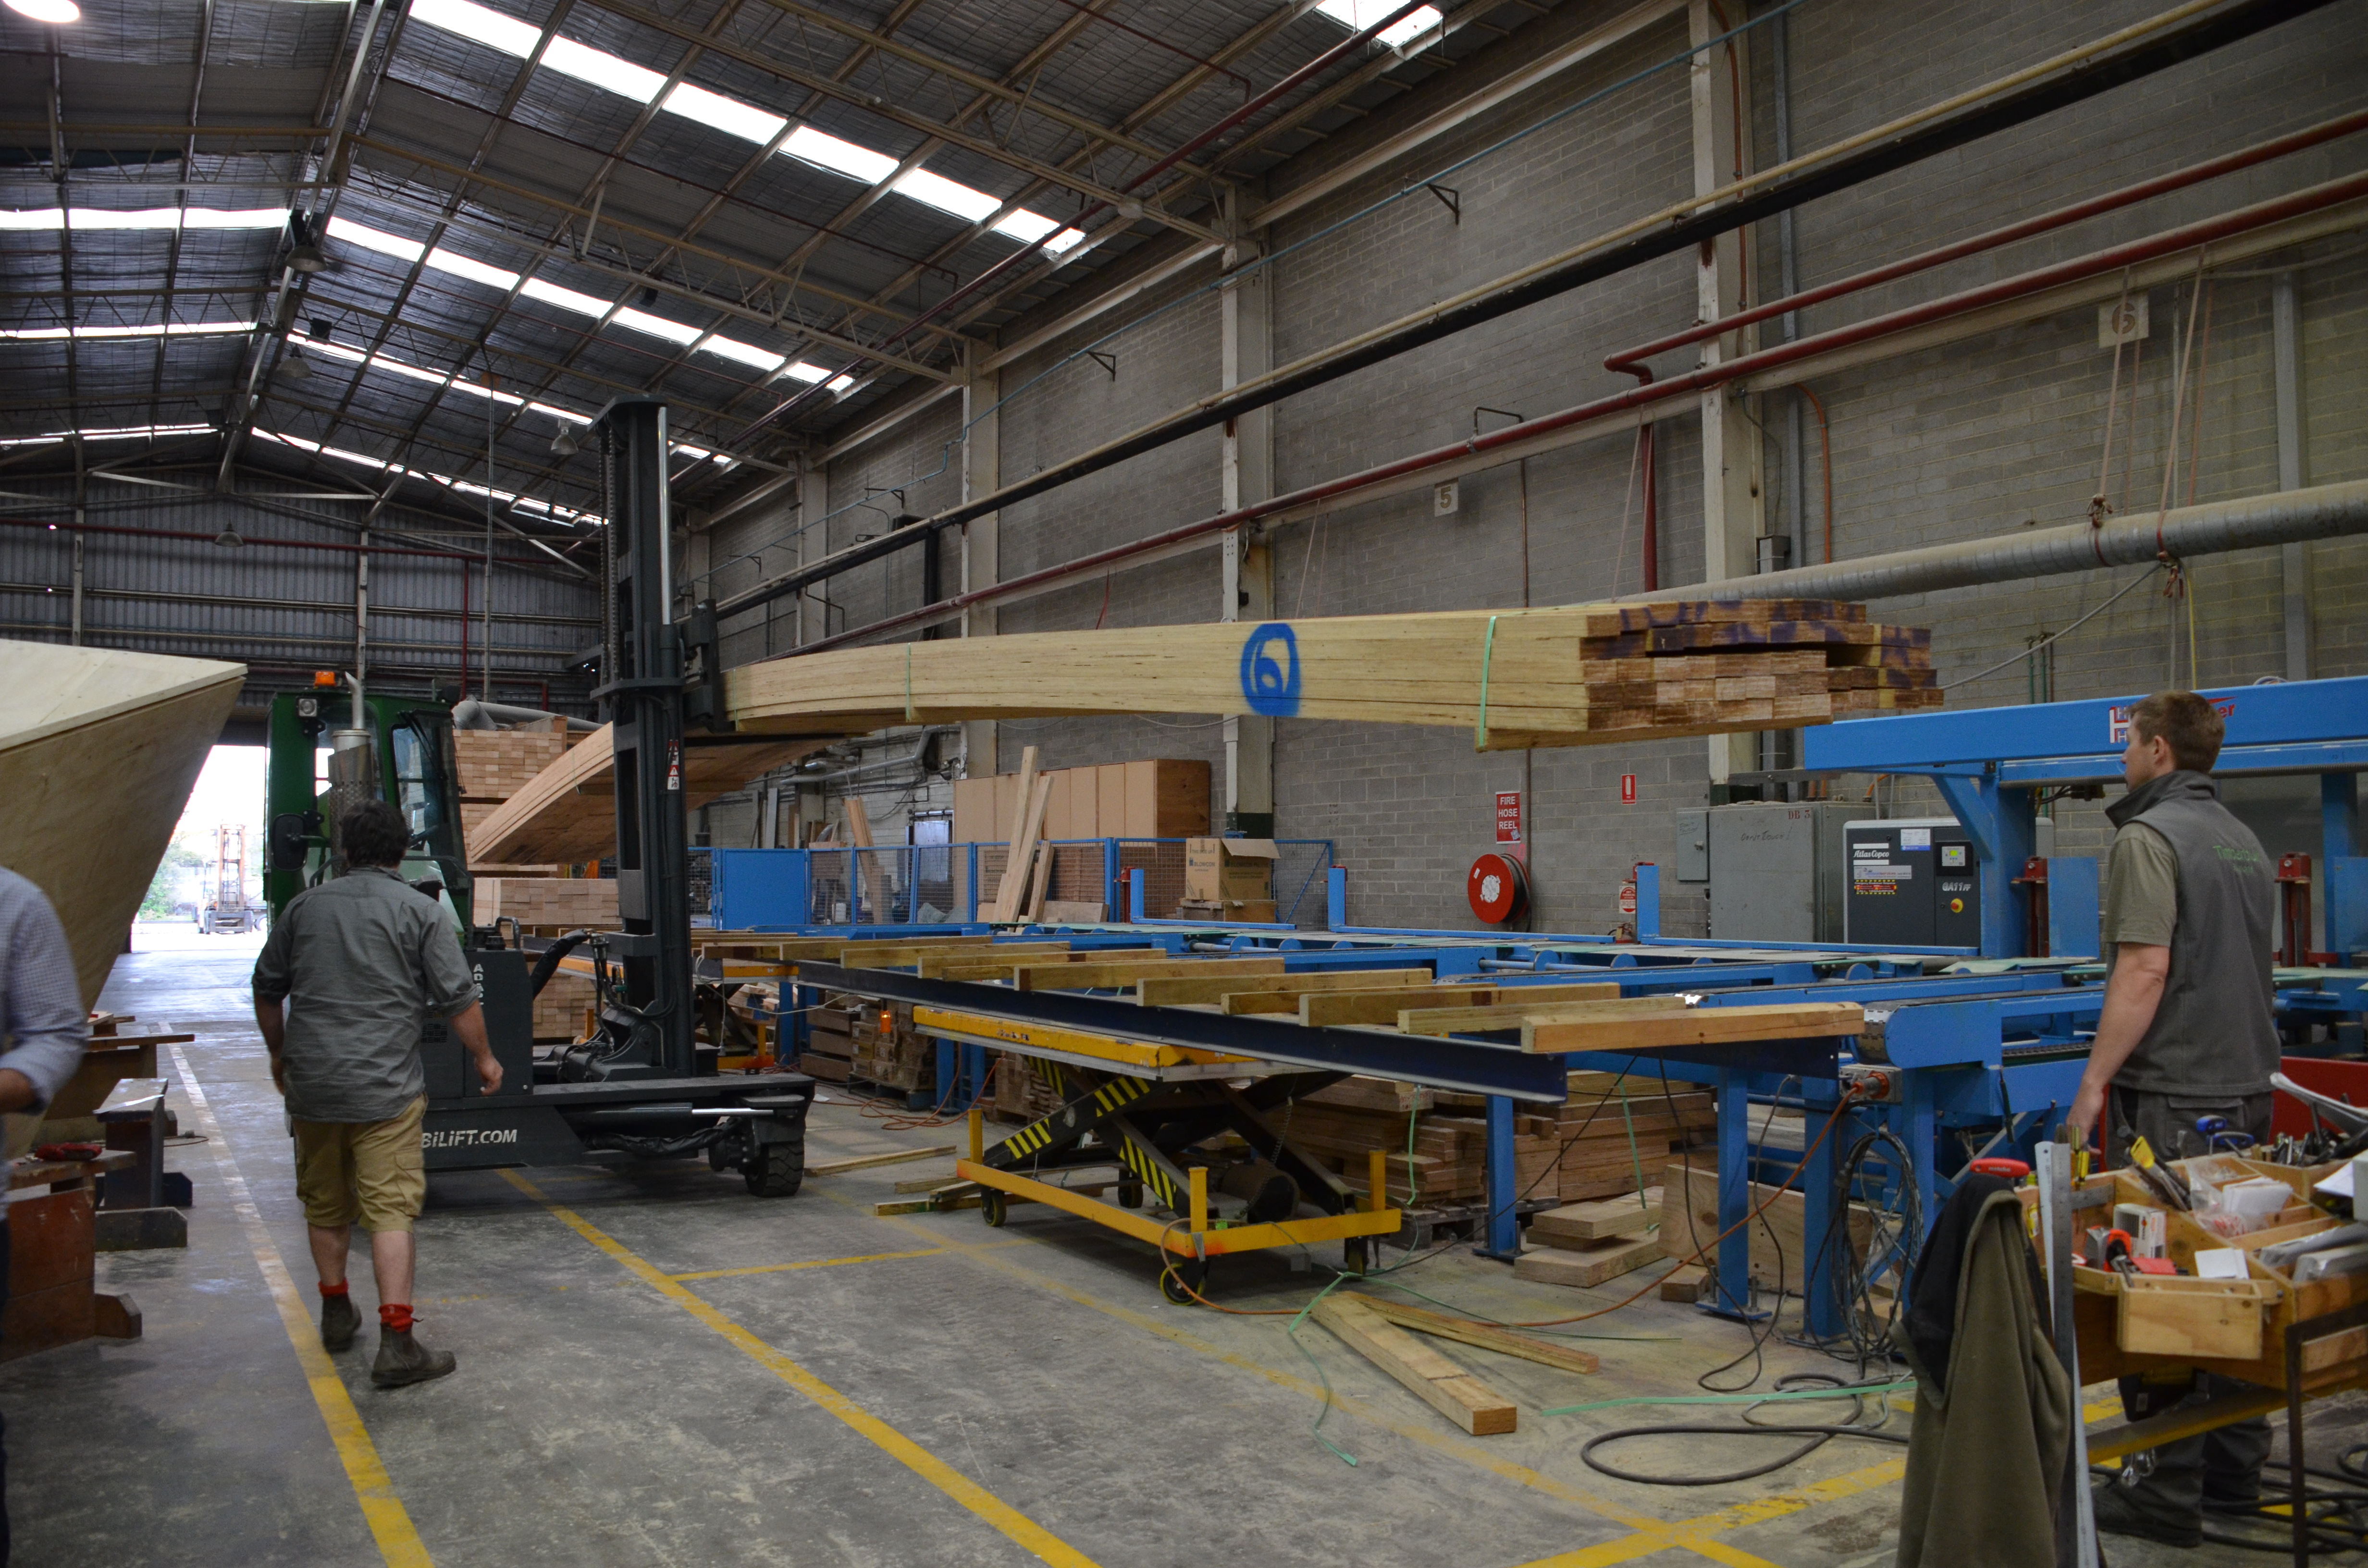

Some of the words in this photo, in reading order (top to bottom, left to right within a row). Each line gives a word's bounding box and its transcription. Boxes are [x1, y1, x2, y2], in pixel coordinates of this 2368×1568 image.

[2111, 302, 2135, 335] 6
[1440, 486, 1452, 509] 5
[1500, 796, 1516, 806] FIRE
[1498, 808, 1518, 818] HOSE
[1788, 810, 1800, 820] DB
[1499, 821, 1517, 830] REEL
[1871, 850, 1889, 859] Copco
